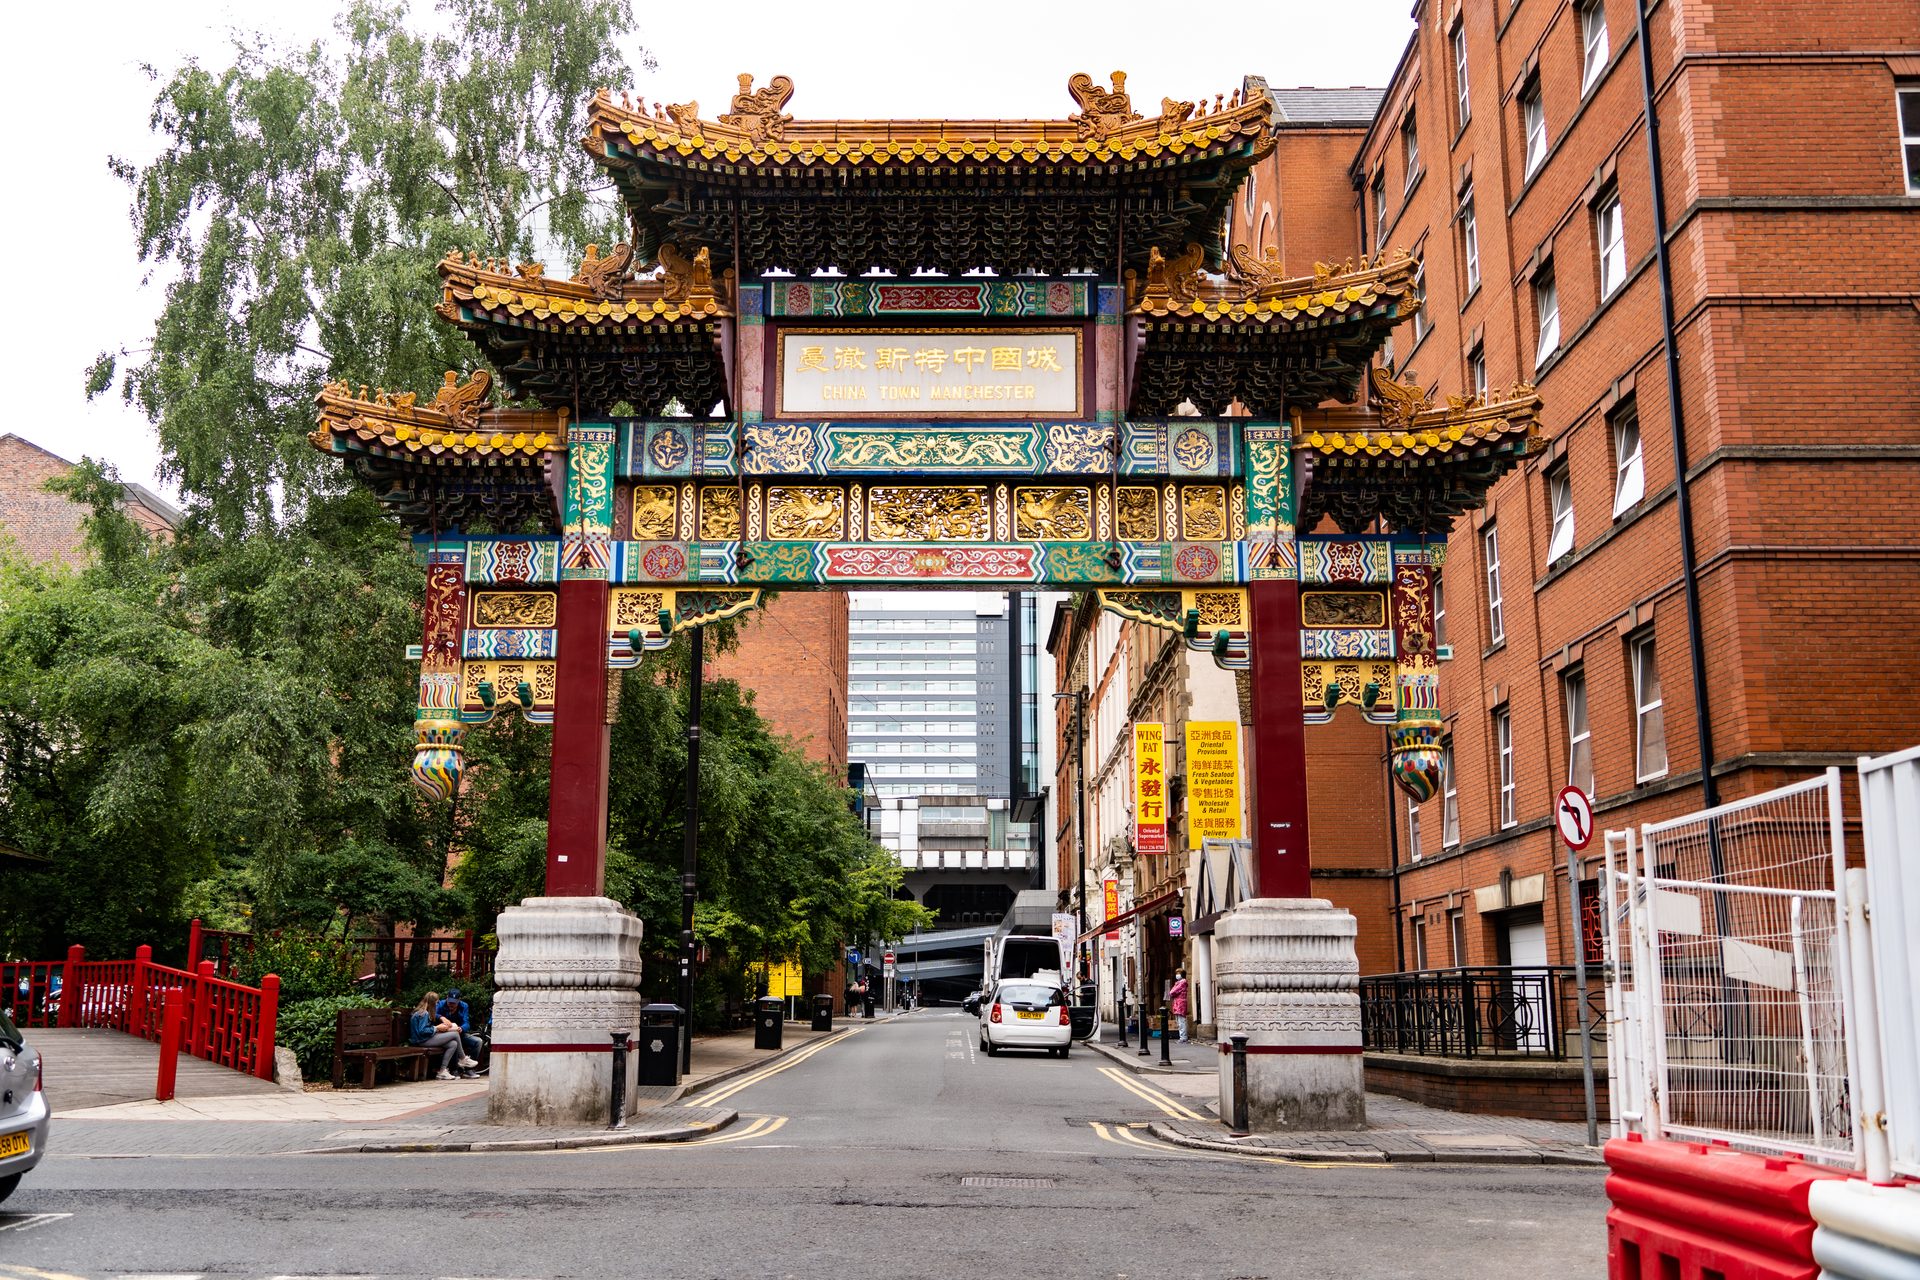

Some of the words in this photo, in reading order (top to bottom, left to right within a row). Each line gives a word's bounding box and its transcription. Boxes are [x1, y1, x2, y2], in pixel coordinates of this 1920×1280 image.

[797, 346, 1064, 373] 曼徹斯特中國城
[823, 384, 868, 400] CHINA
[879, 385, 920, 400] TOWN
[930, 384, 1036, 400] MANCHESTER
[1137, 731, 1162, 740] WING
[1190, 730, 1232, 740] 亞洲食品
[1143, 743, 1158, 752] FAT
[1192, 760, 1234, 770] 海鮮蔬菜
[1201, 778, 1234, 786] Vegetables
[1140, 757, 1162, 818] 永發行
[1193, 818, 1236, 828] 送貨服務
[1202, 829, 1228, 837] Delivery
